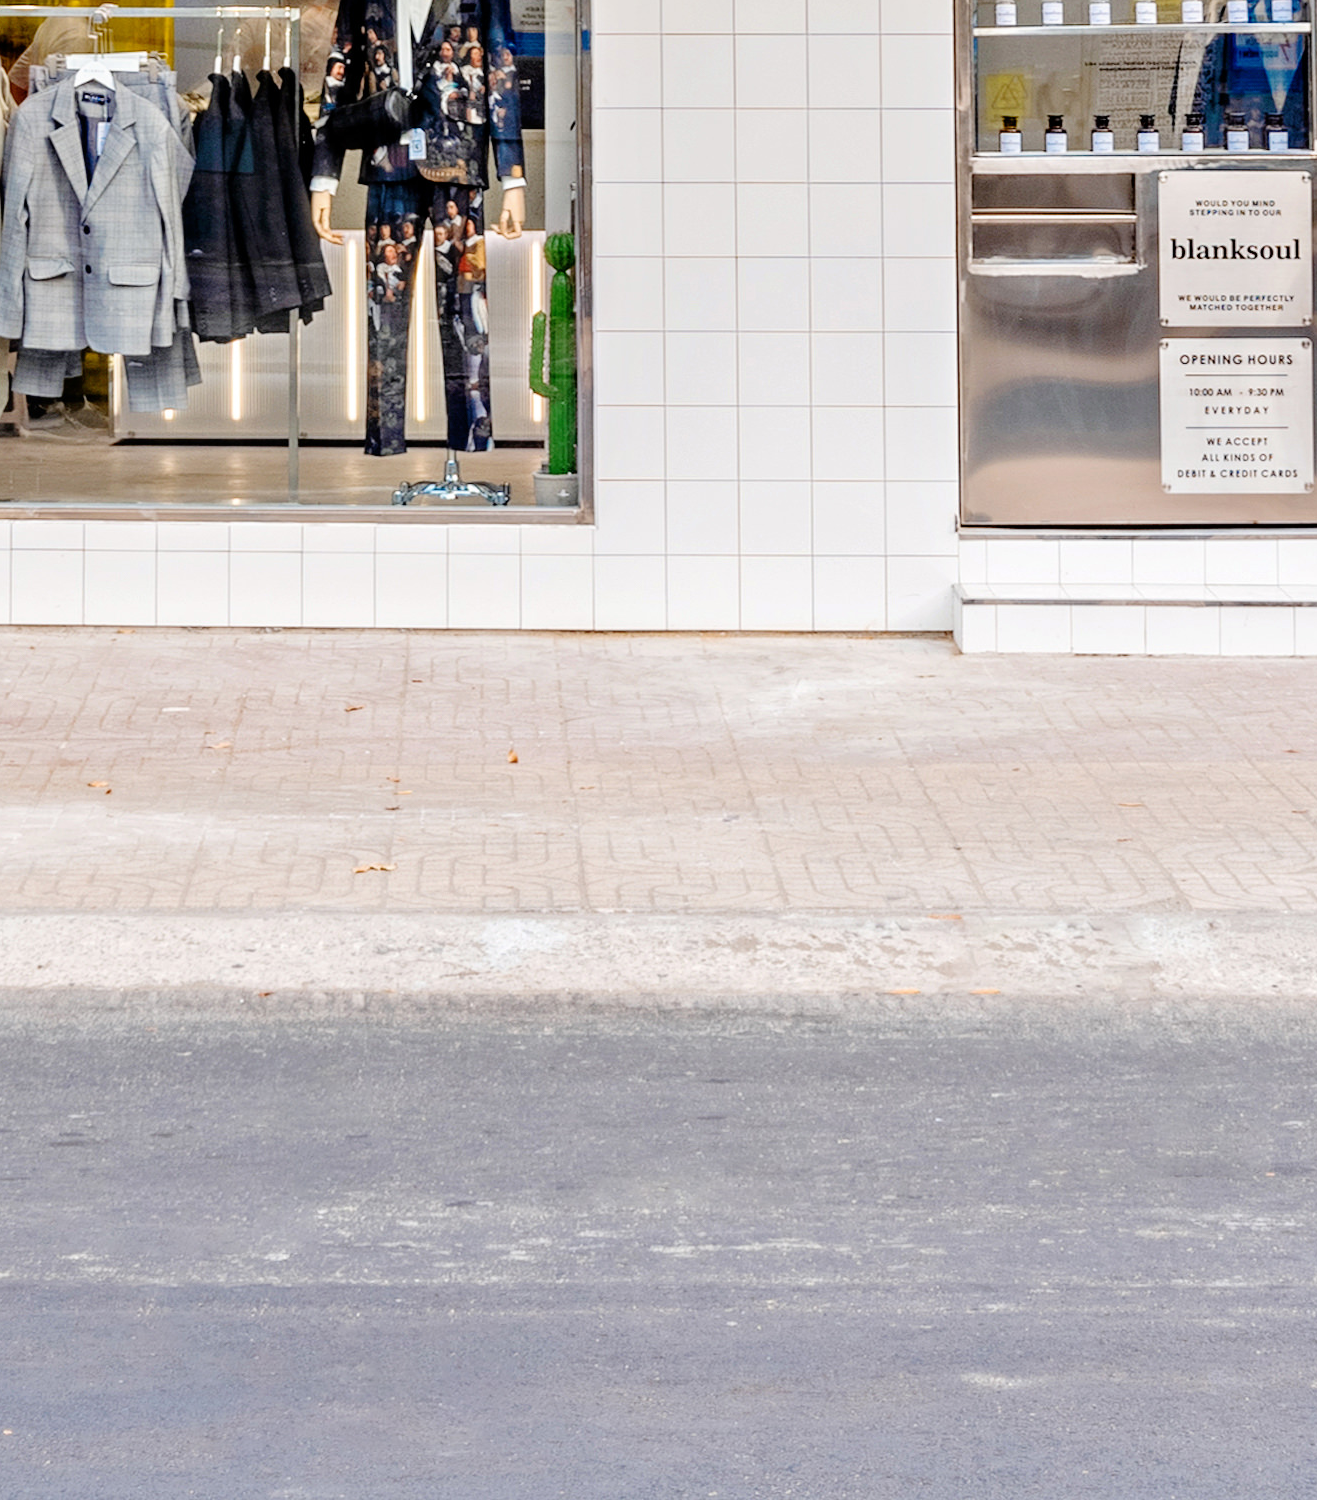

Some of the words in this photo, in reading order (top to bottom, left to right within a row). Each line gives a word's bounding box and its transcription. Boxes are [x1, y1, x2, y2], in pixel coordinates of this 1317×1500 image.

[1196, 200, 1229, 208] WOULD
[1231, 200, 1250, 208] YOU
[1252, 200, 1276, 208] MIND
[1170, 238, 1302, 260] blanksoul
[1179, 354, 1243, 365] OPENING
[1247, 354, 1294, 365] HOURS
[1189, 388, 1214, 396] 10:00
[1216, 388, 1233, 396] AM
[1248, 388, 1268, 396] 9:30
[1270, 388, 1285, 396] PM
[1204, 406, 1270, 415] EVERYDAY
[1206, 438, 1222, 446] WE
[1225, 438, 1268, 446] ACCEPT
[1201, 454, 1219, 462] ALL
[1223, 454, 1256, 462] KINDS
[1258, 454, 1274, 462] OF
[1177, 470, 1206, 478] DEBIT
[1220, 470, 1258, 478] CREDIT
[1261, 469, 1299, 478] CARDS
